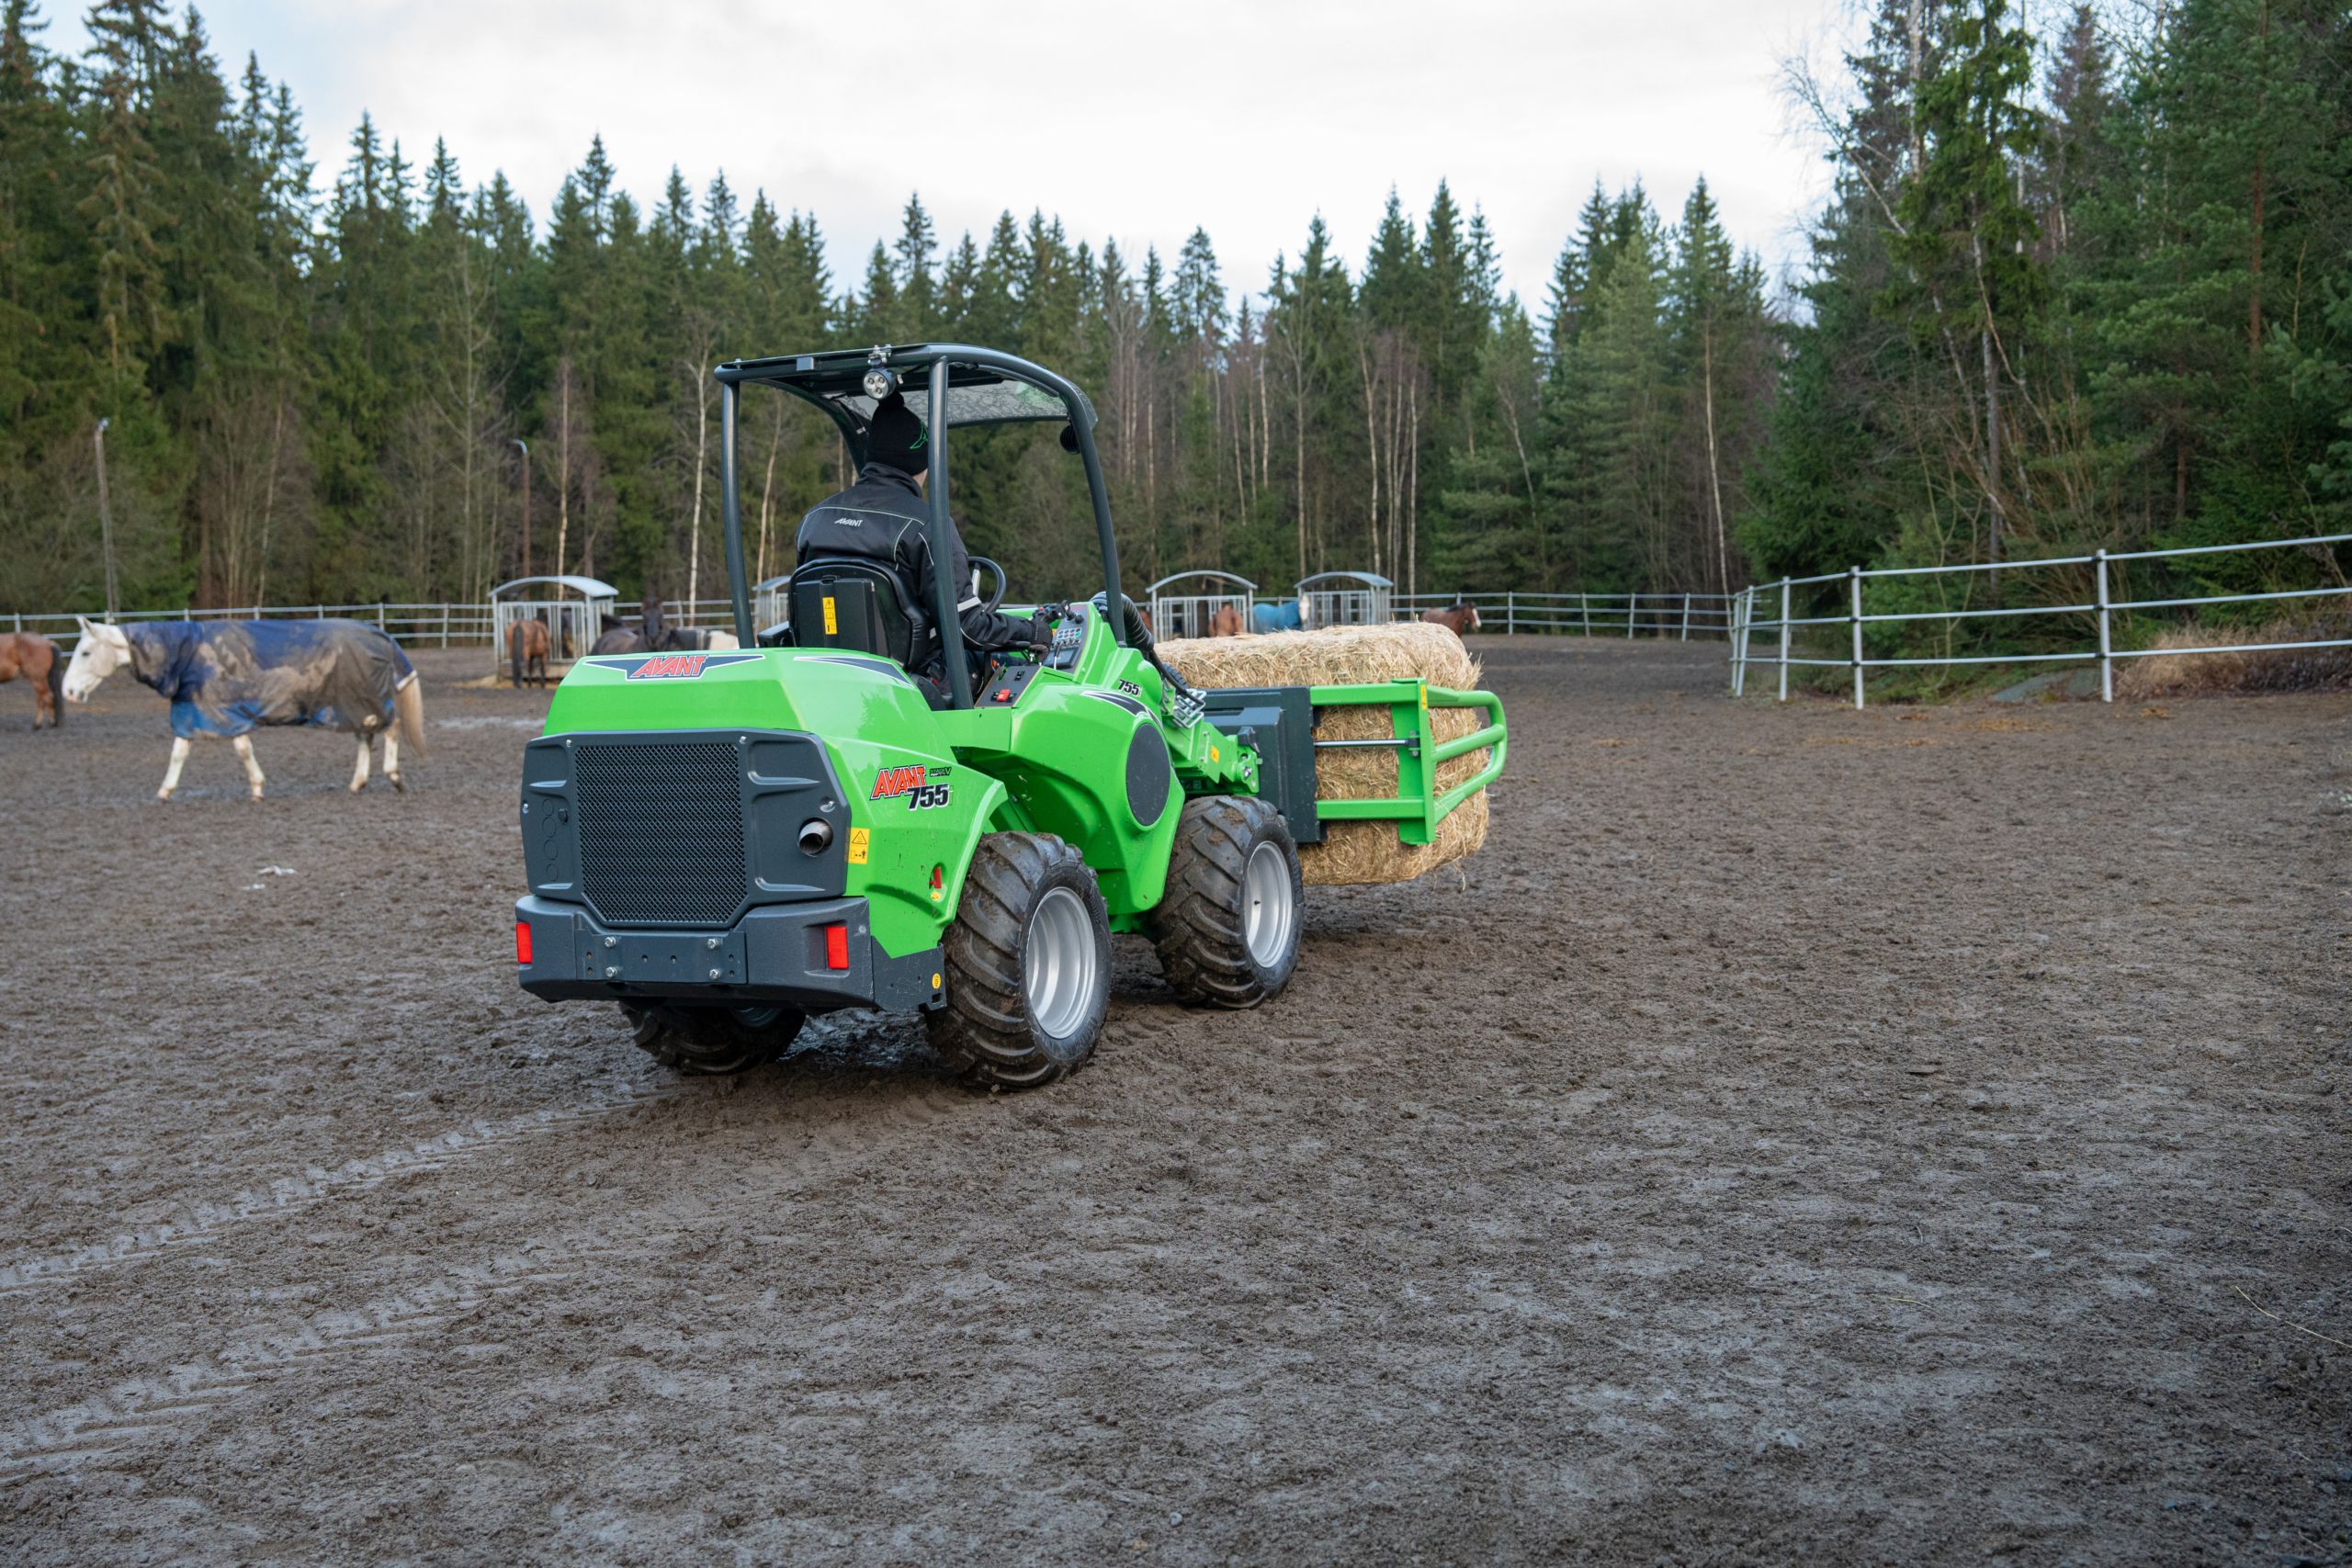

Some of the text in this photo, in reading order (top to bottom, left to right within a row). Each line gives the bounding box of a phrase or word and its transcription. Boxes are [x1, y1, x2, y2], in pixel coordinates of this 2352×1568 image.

[834, 517, 863, 526] AVANT
[630, 655, 707, 677] AVANT
[871, 765, 926, 798] AVANT
